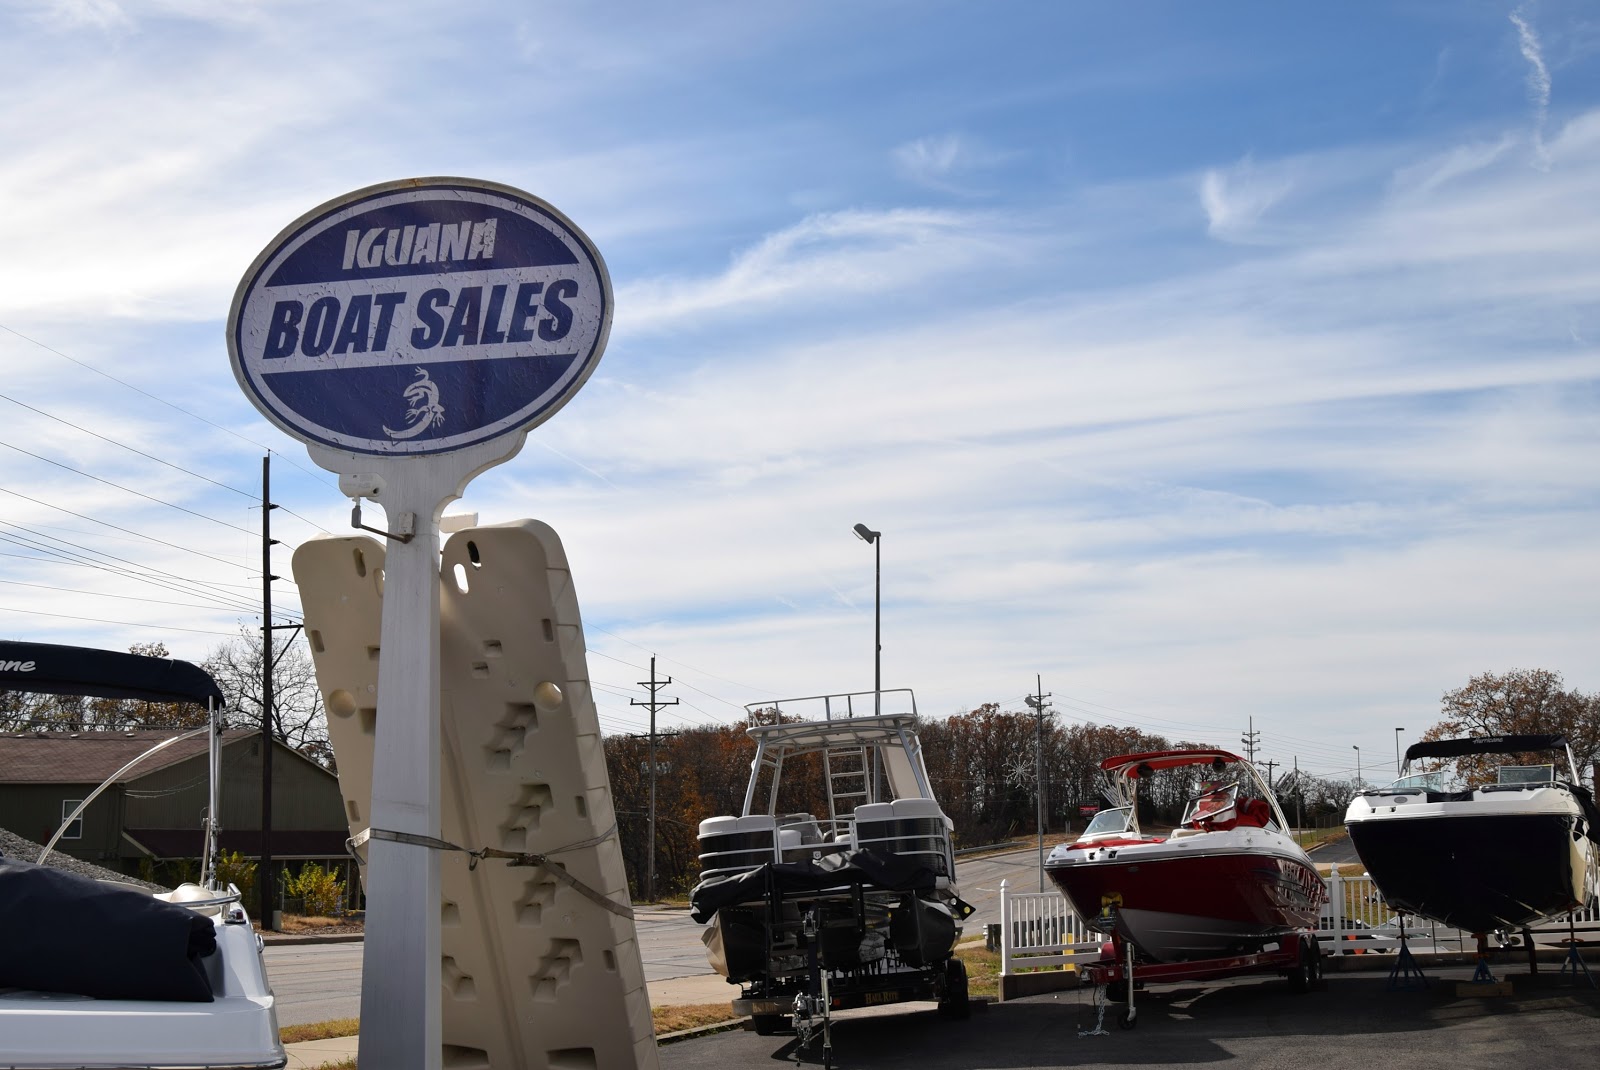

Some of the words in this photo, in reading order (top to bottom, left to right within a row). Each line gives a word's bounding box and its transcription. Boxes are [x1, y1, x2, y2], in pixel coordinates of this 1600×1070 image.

[342, 218, 497, 270] IGUANA
[263, 291, 406, 359] BOAT
[411, 279, 579, 350] SALES
